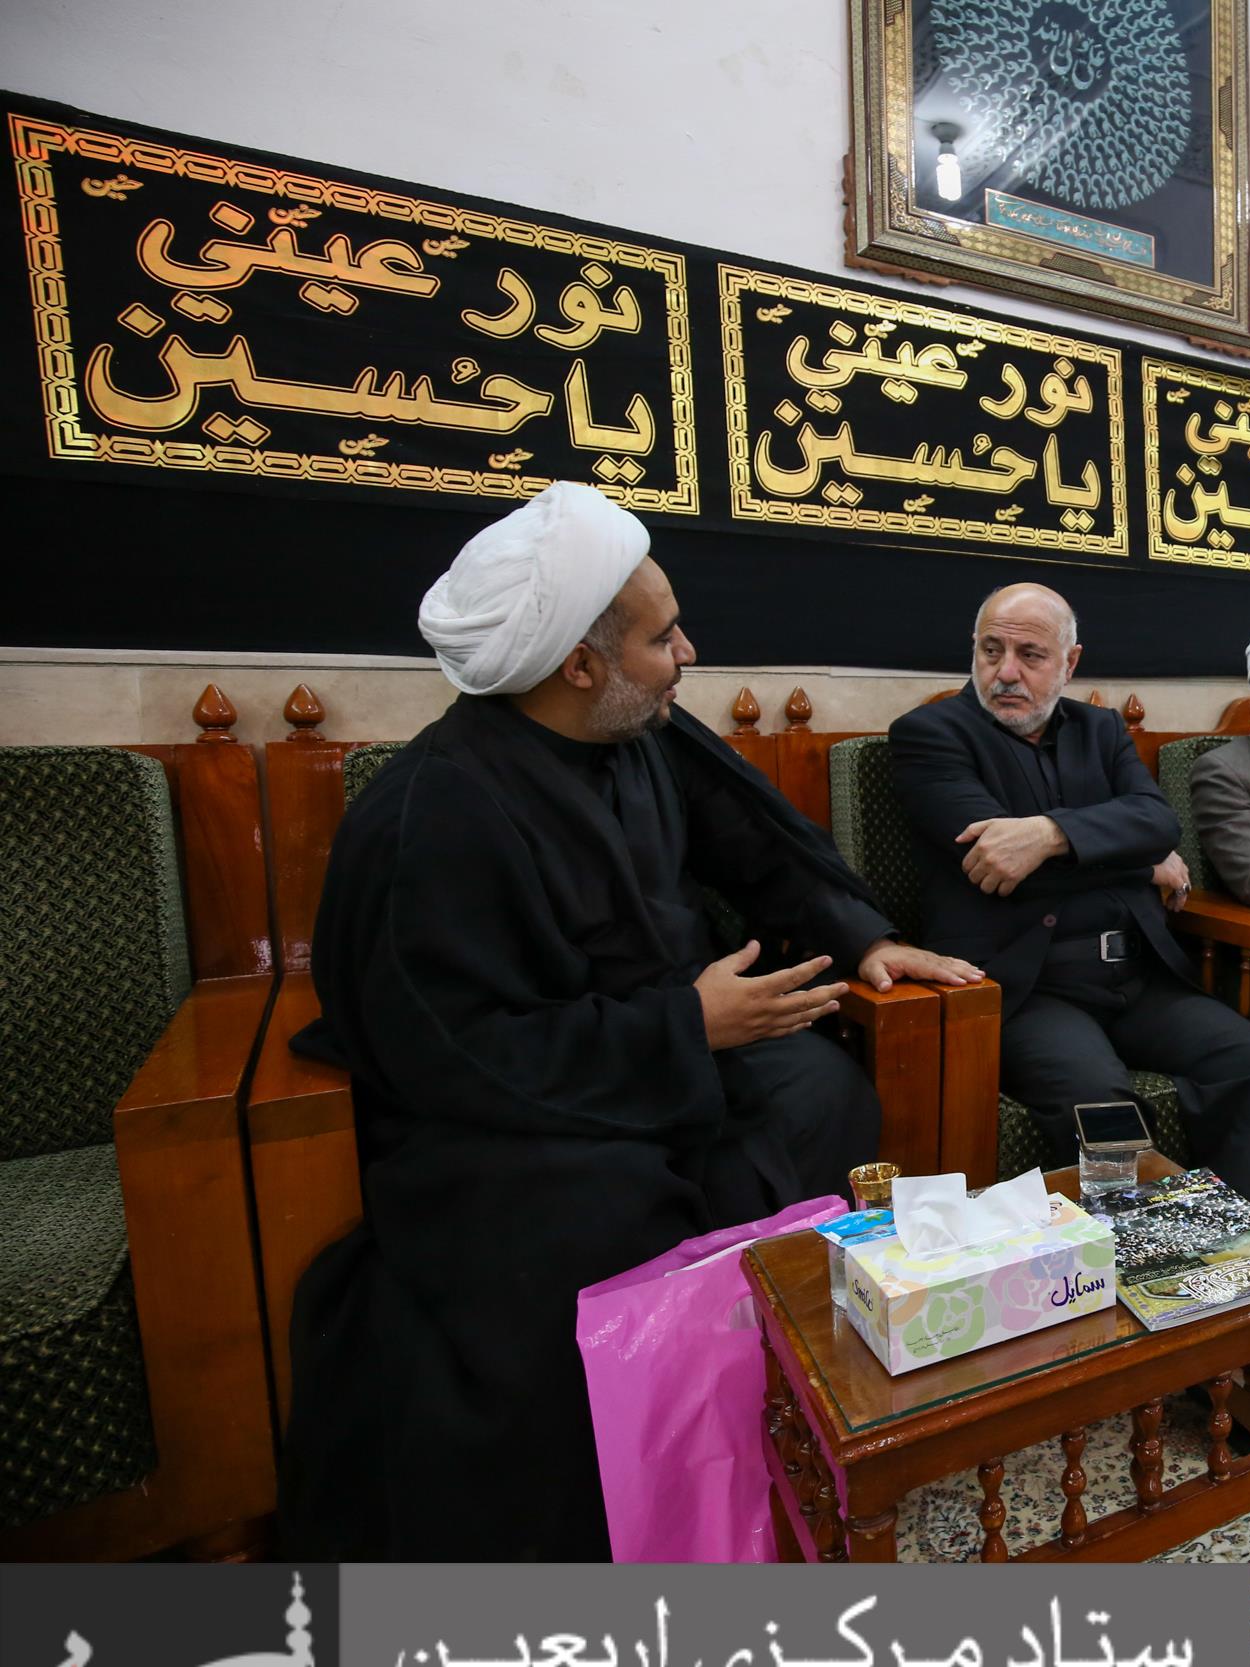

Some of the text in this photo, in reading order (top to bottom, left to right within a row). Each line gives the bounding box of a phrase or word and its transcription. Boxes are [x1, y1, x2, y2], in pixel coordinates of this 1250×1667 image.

[136, 200, 642, 352] نور عيني
[564, 359, 655, 484] يا
[786, 320, 1094, 428] نور عيني
[1043, 433, 1101, 532] يا
[1050, 1271, 1106, 1307] سمايل
